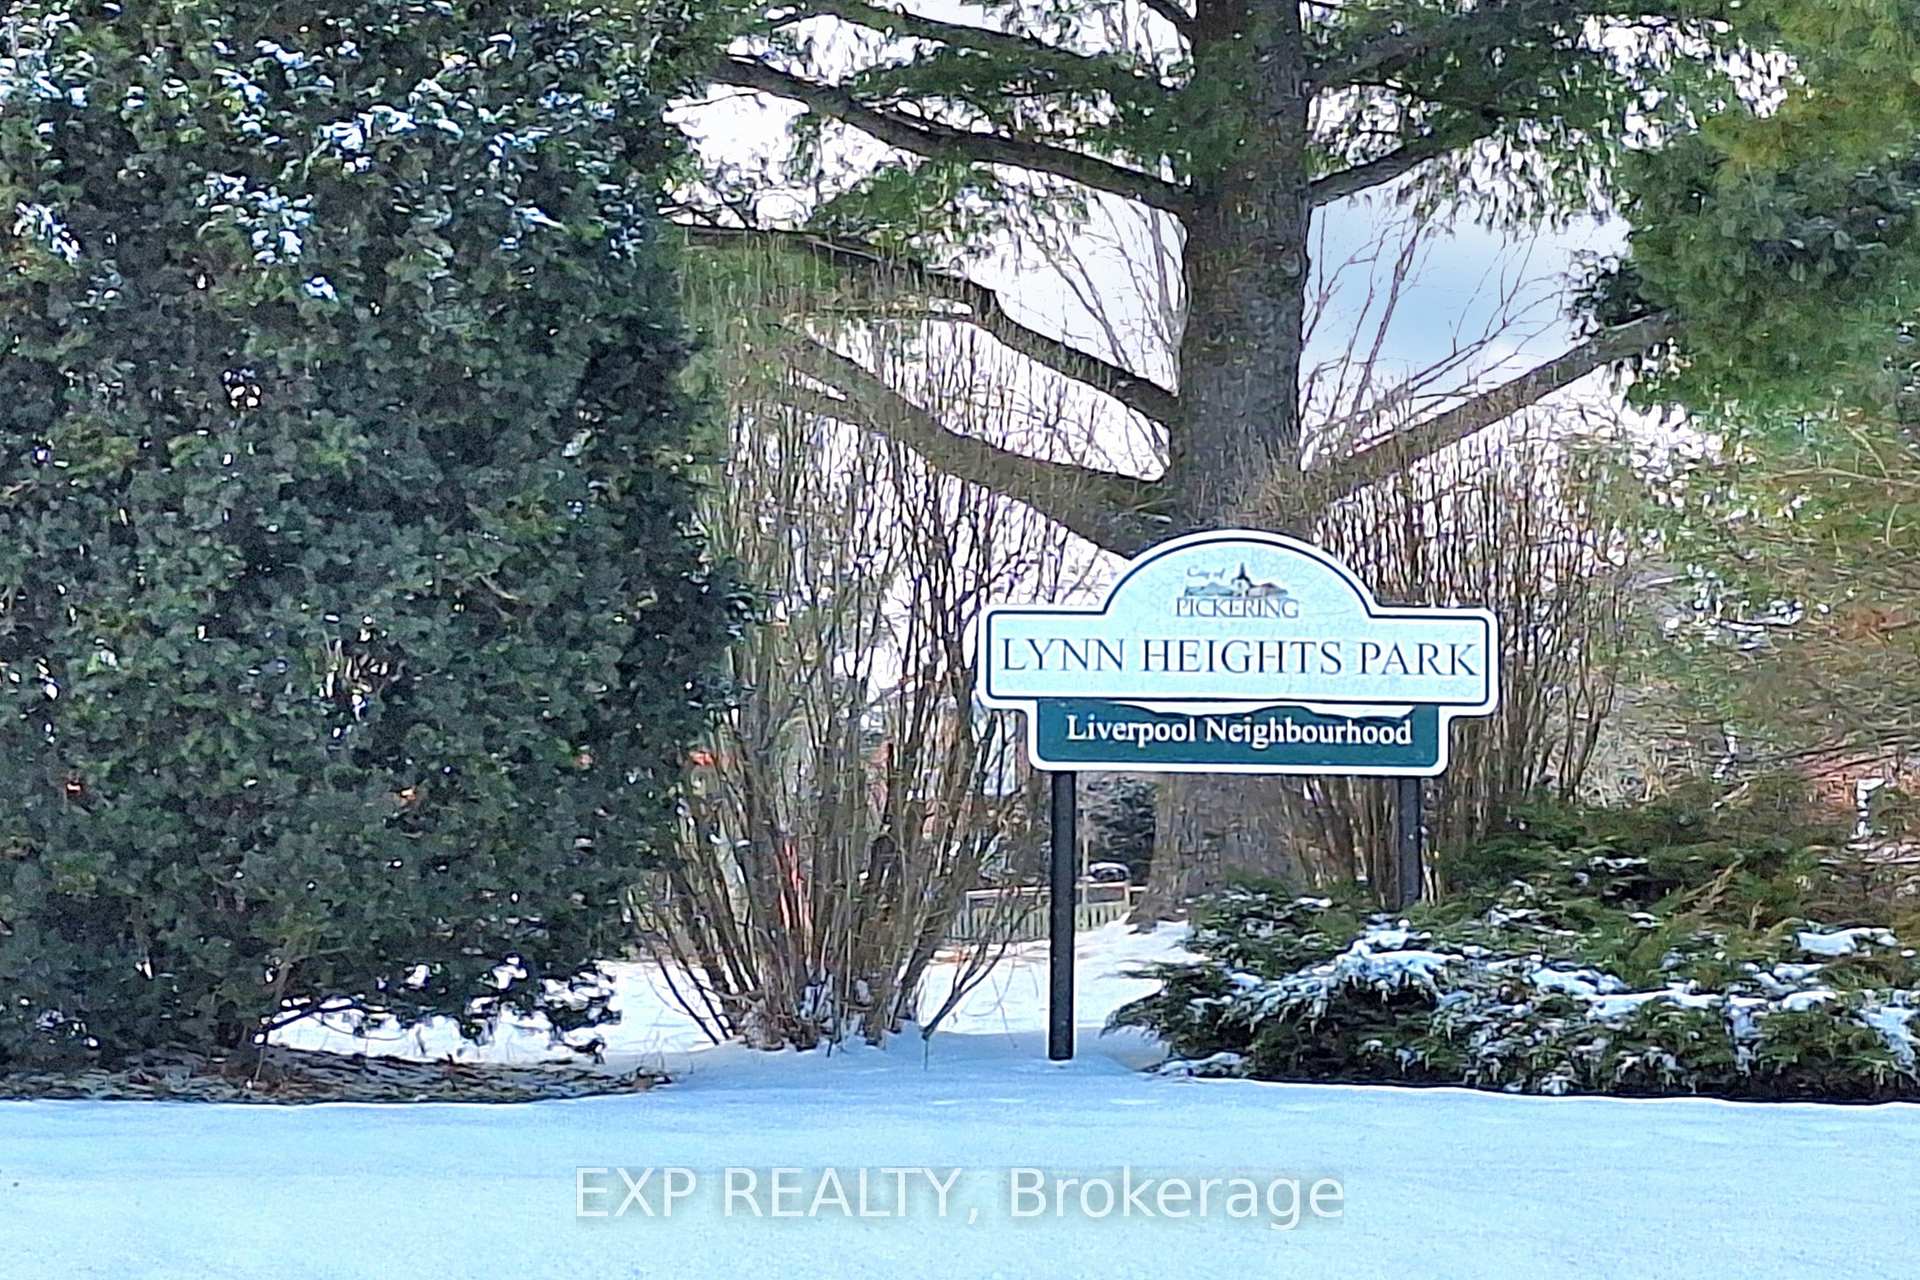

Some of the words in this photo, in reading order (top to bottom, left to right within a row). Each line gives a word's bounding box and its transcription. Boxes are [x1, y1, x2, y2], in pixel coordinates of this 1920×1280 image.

[1176, 597, 1300, 619] PICKERING
[1000, 637, 1124, 672] LYNN
[1143, 638, 1342, 675] HEIGHTS
[1360, 641, 1481, 677] PARK
[1066, 714, 1196, 745] Liverpool
[1205, 717, 1412, 750] Neighbourhood
